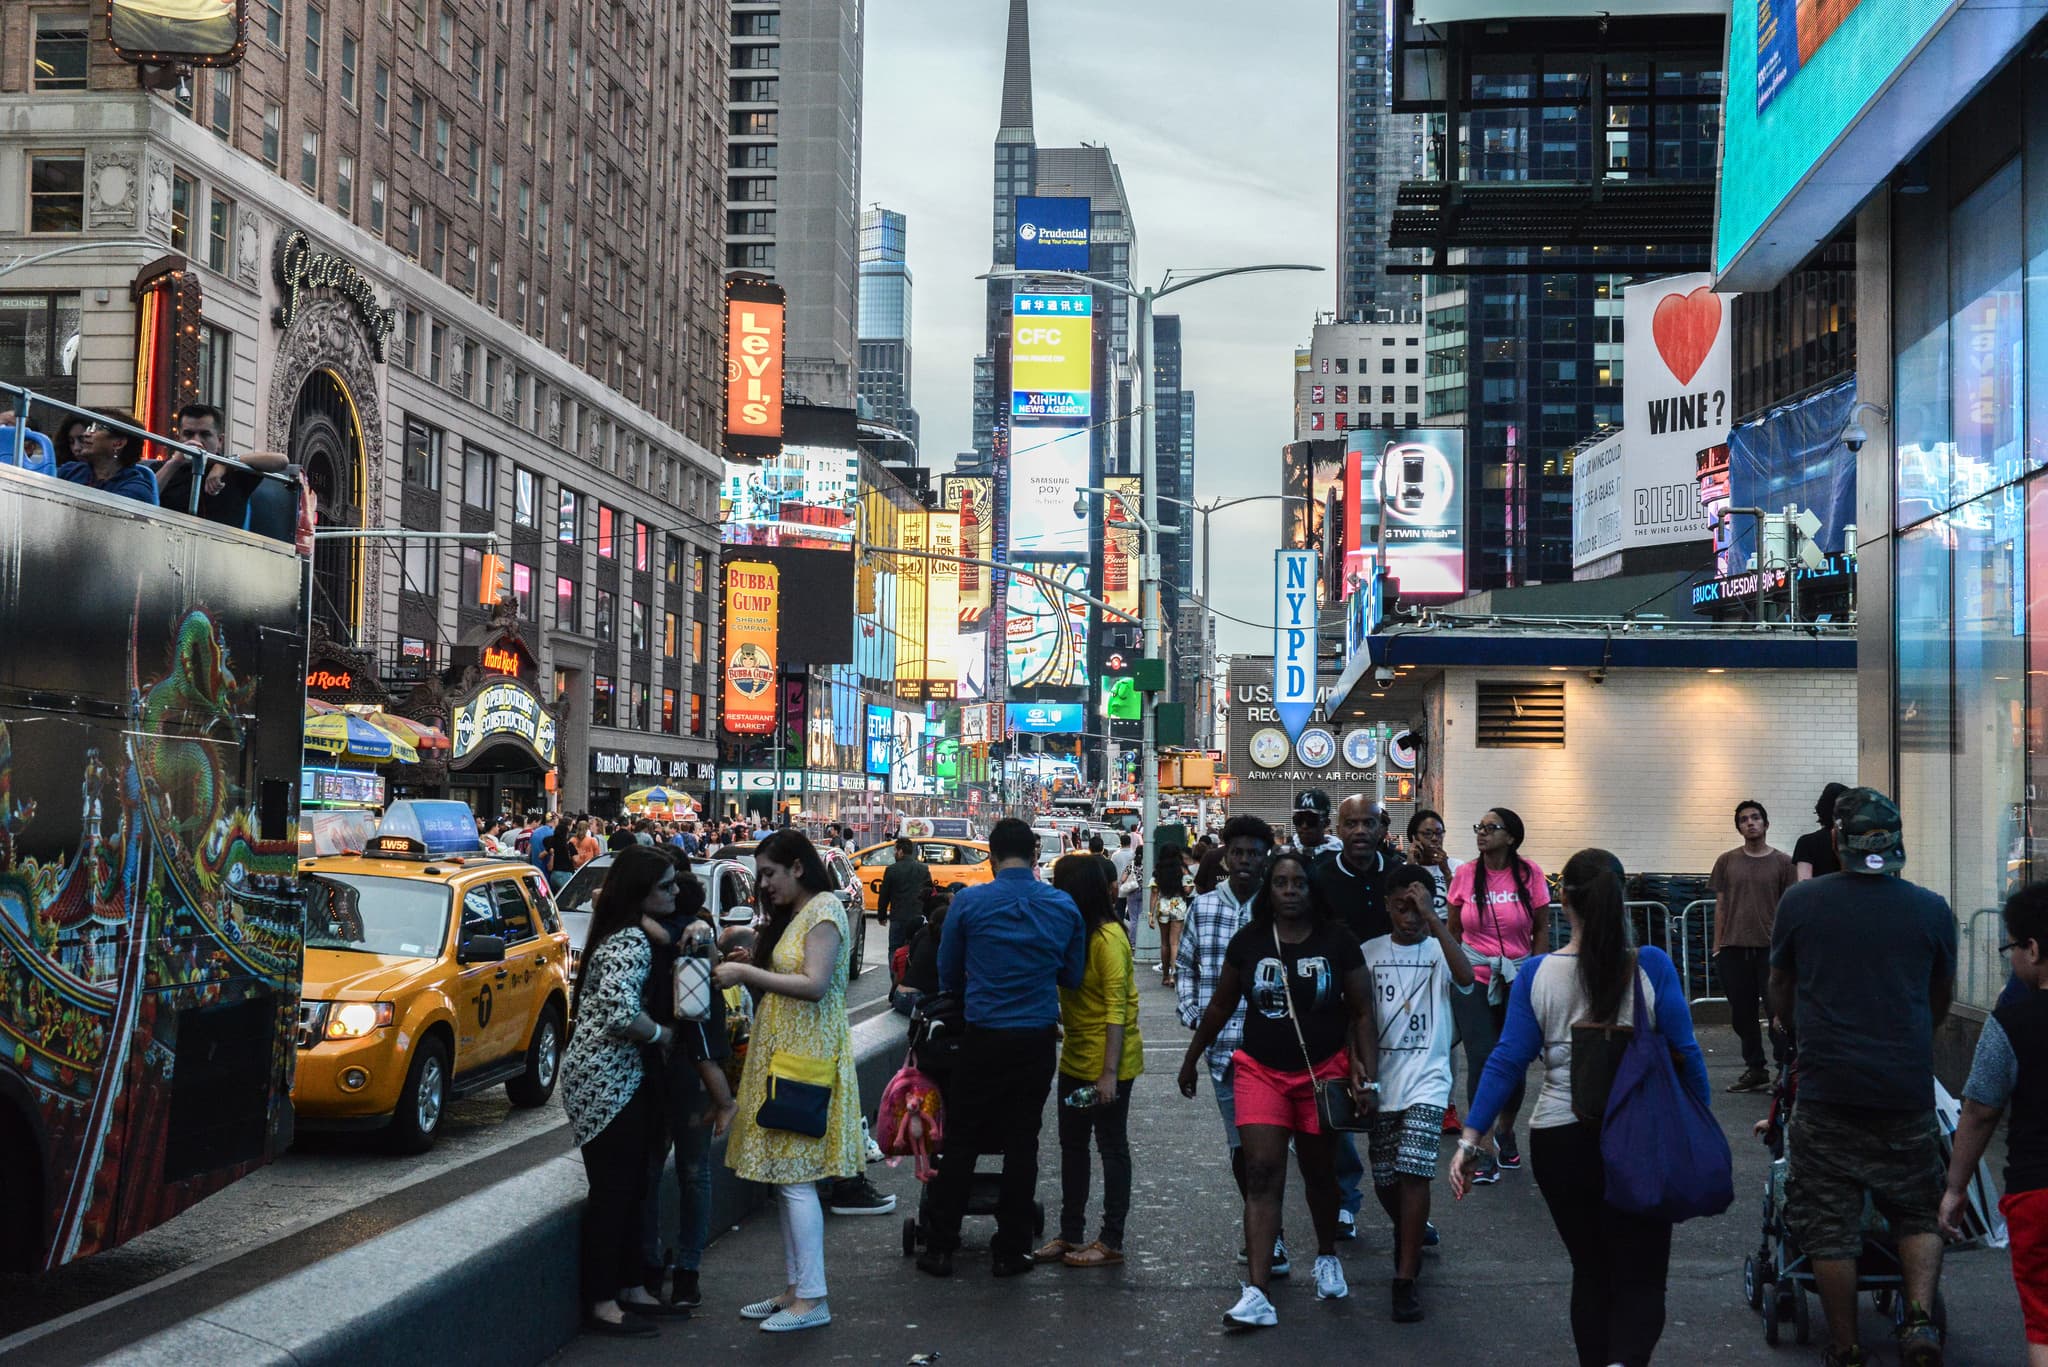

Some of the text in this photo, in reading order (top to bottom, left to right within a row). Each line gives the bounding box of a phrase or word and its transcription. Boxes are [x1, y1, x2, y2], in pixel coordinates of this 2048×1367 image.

[1039, 228, 1087, 238] Prudential
[1017, 328, 1061, 345] CFC
[1029, 394, 1075, 405] XINHUA
[1018, 405, 1084, 414] NEWS AGENCY
[1038, 486, 1060, 495] pay
[1634, 482, 1707, 526] RIEDE
[1394, 529, 1421, 538] TWIN
[1651, 527, 1670, 535] WINE
[1673, 524, 1698, 533] GLASS
[936, 536, 951, 544] THE
[932, 559, 957, 575] KING
[730, 570, 775, 591] BUBBA
[1720, 574, 1758, 598] TUESDAY
[733, 592, 771, 612] GUMP
[731, 624, 772, 632] COMPANY
[1286, 557, 1307, 697] NYPD
[319, 672, 351, 689] Rock
[729, 669, 773, 681] BUBBA GUMP
[1239, 686, 1272, 703] U.S.
[482, 711, 535, 739] CONSTRUCTION
[727, 713, 773, 722] RESTAURANT
[735, 722, 766, 730] MARKET
[614, 754, 629, 774] GUMP
[1248, 771, 1275, 780] ARMY
[1284, 771, 1313, 780] NAVY
[1325, 771, 1341, 780] AIR
[380, 840, 409, 850] 1W56
[1471, 889, 1519, 905] dida
[1377, 985, 1395, 1003] 19
[1409, 1014, 1426, 1031] 81
